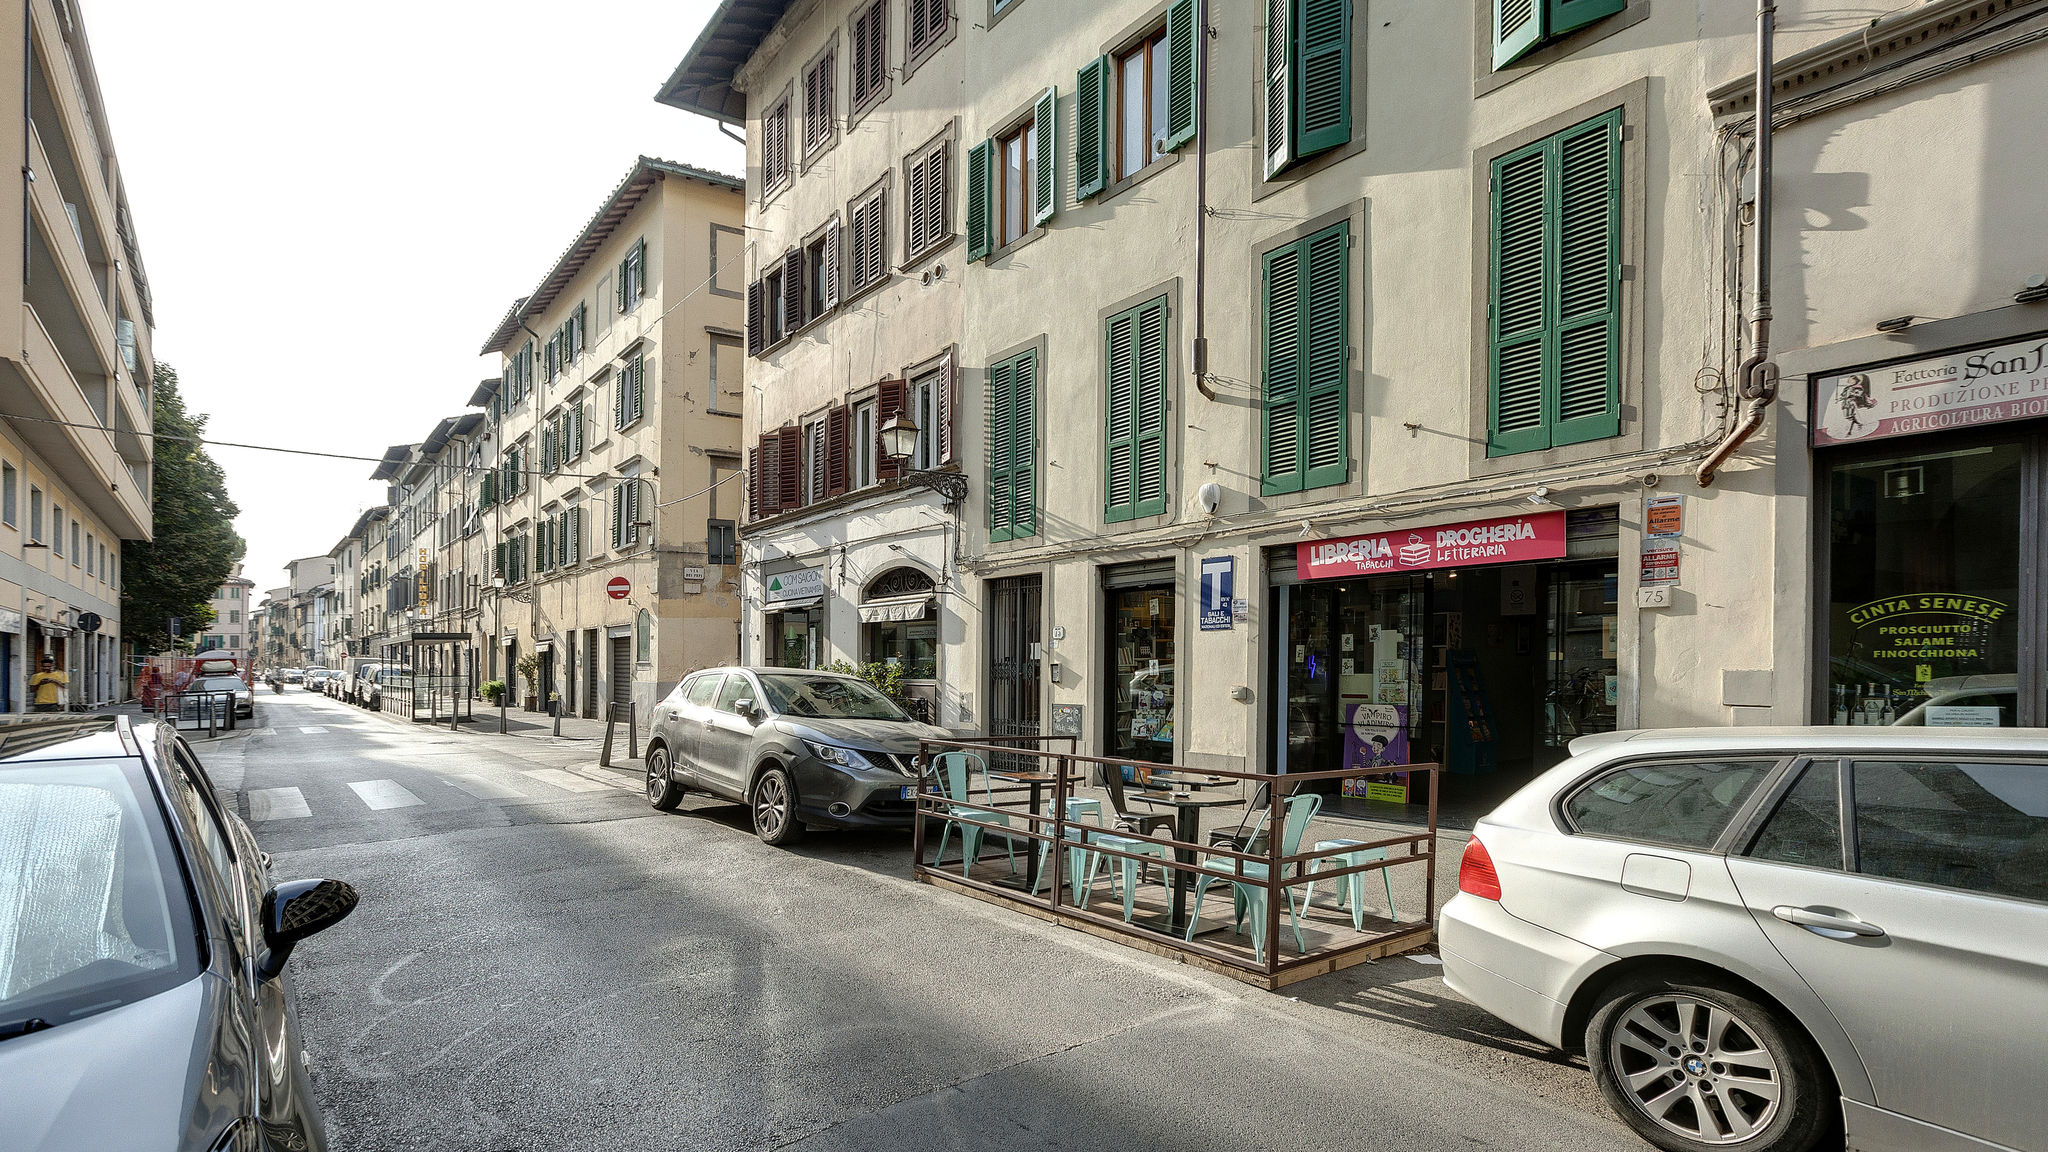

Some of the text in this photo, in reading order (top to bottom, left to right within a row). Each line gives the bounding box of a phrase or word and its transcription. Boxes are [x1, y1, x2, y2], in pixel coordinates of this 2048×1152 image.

[1892, 365, 1958, 384] Fattoria
[1890, 381, 2020, 413] PRODUZIONE
[1890, 405, 2003, 434] AGRICOLTURA
[1436, 519, 1536, 548] DROGHERIA
[1310, 537, 1393, 567] LIBRERIA
[1436, 544, 1507, 562] LETTERARIA
[1643, 553, 1677, 561] ALLARME
[1355, 559, 1394, 571] TABACCHI
[783, 570, 821, 586] COM SAIGON
[1203, 561, 1231, 610] T
[1645, 590, 1663, 603] 75
[1850, 597, 2005, 624] CINTA SENESE
[1200, 616, 1231, 625] TABACCHI
[1879, 624, 1972, 635] PROSCIUTTO
[1894, 637, 1955, 646] SALAME
[1873, 648, 1978, 658] FINOCCHIONA
[1361, 712, 1392, 721] VAMPIRO
